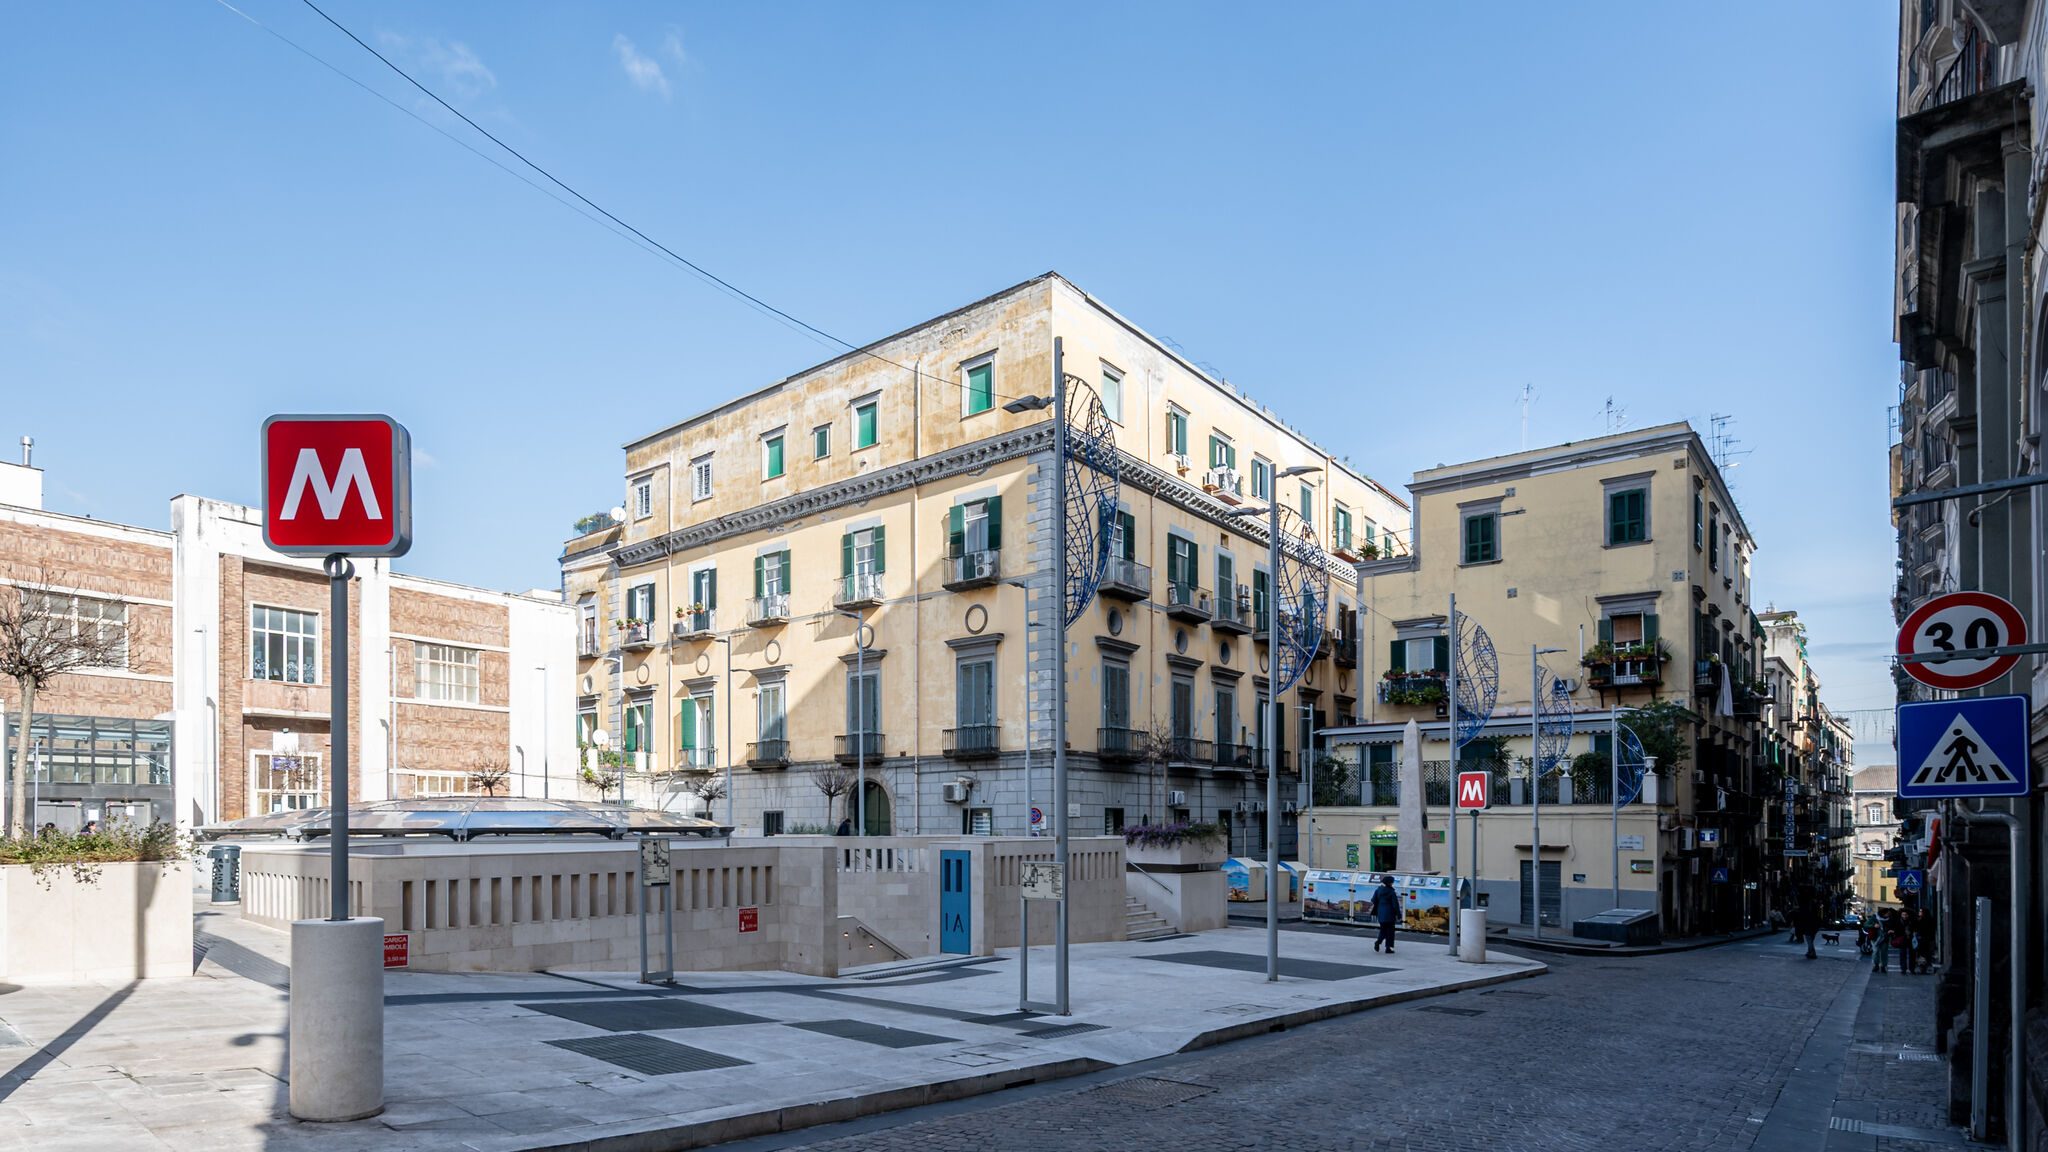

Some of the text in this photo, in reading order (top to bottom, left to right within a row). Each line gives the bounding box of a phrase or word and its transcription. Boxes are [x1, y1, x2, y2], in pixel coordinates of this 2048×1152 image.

[279, 448, 383, 520] M
[1924, 617, 1999, 665] 30
[1461, 780, 1483, 801] M
